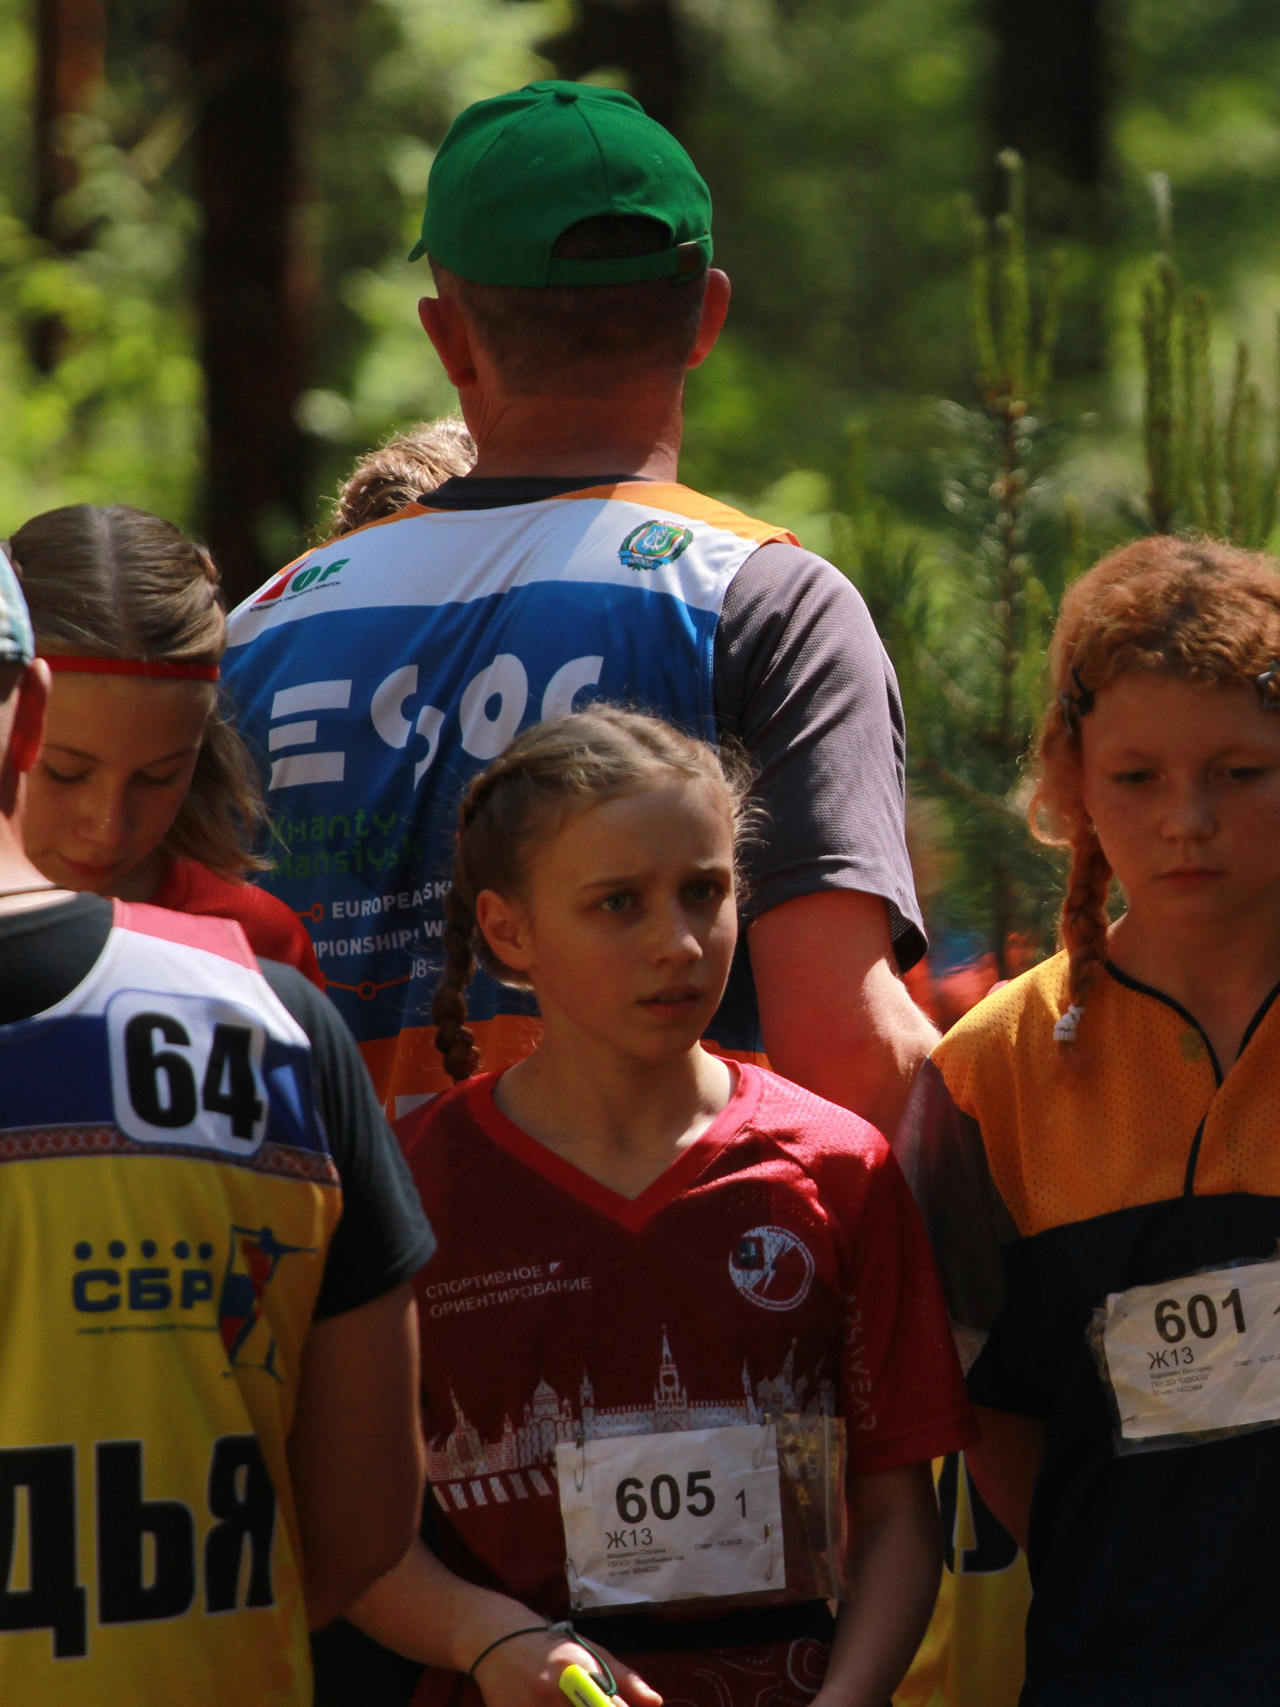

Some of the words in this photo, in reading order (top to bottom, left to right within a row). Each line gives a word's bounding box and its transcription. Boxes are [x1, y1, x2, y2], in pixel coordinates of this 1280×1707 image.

[122, 1011, 265, 1142] 64
[73, 1267, 213, 1313] СБР
[425, 1264, 543, 1299] СПОРТИВНОЕ
[430, 1276, 592, 1319] ОРИЕНТИРОВАНИЕ
[1154, 1287, 1247, 1344] 601
[1147, 1346, 1194, 1370] Ж13
[615, 1470, 716, 1524] 605
[735, 1488, 746, 1518] 1
[605, 1527, 653, 1549] Ж13
